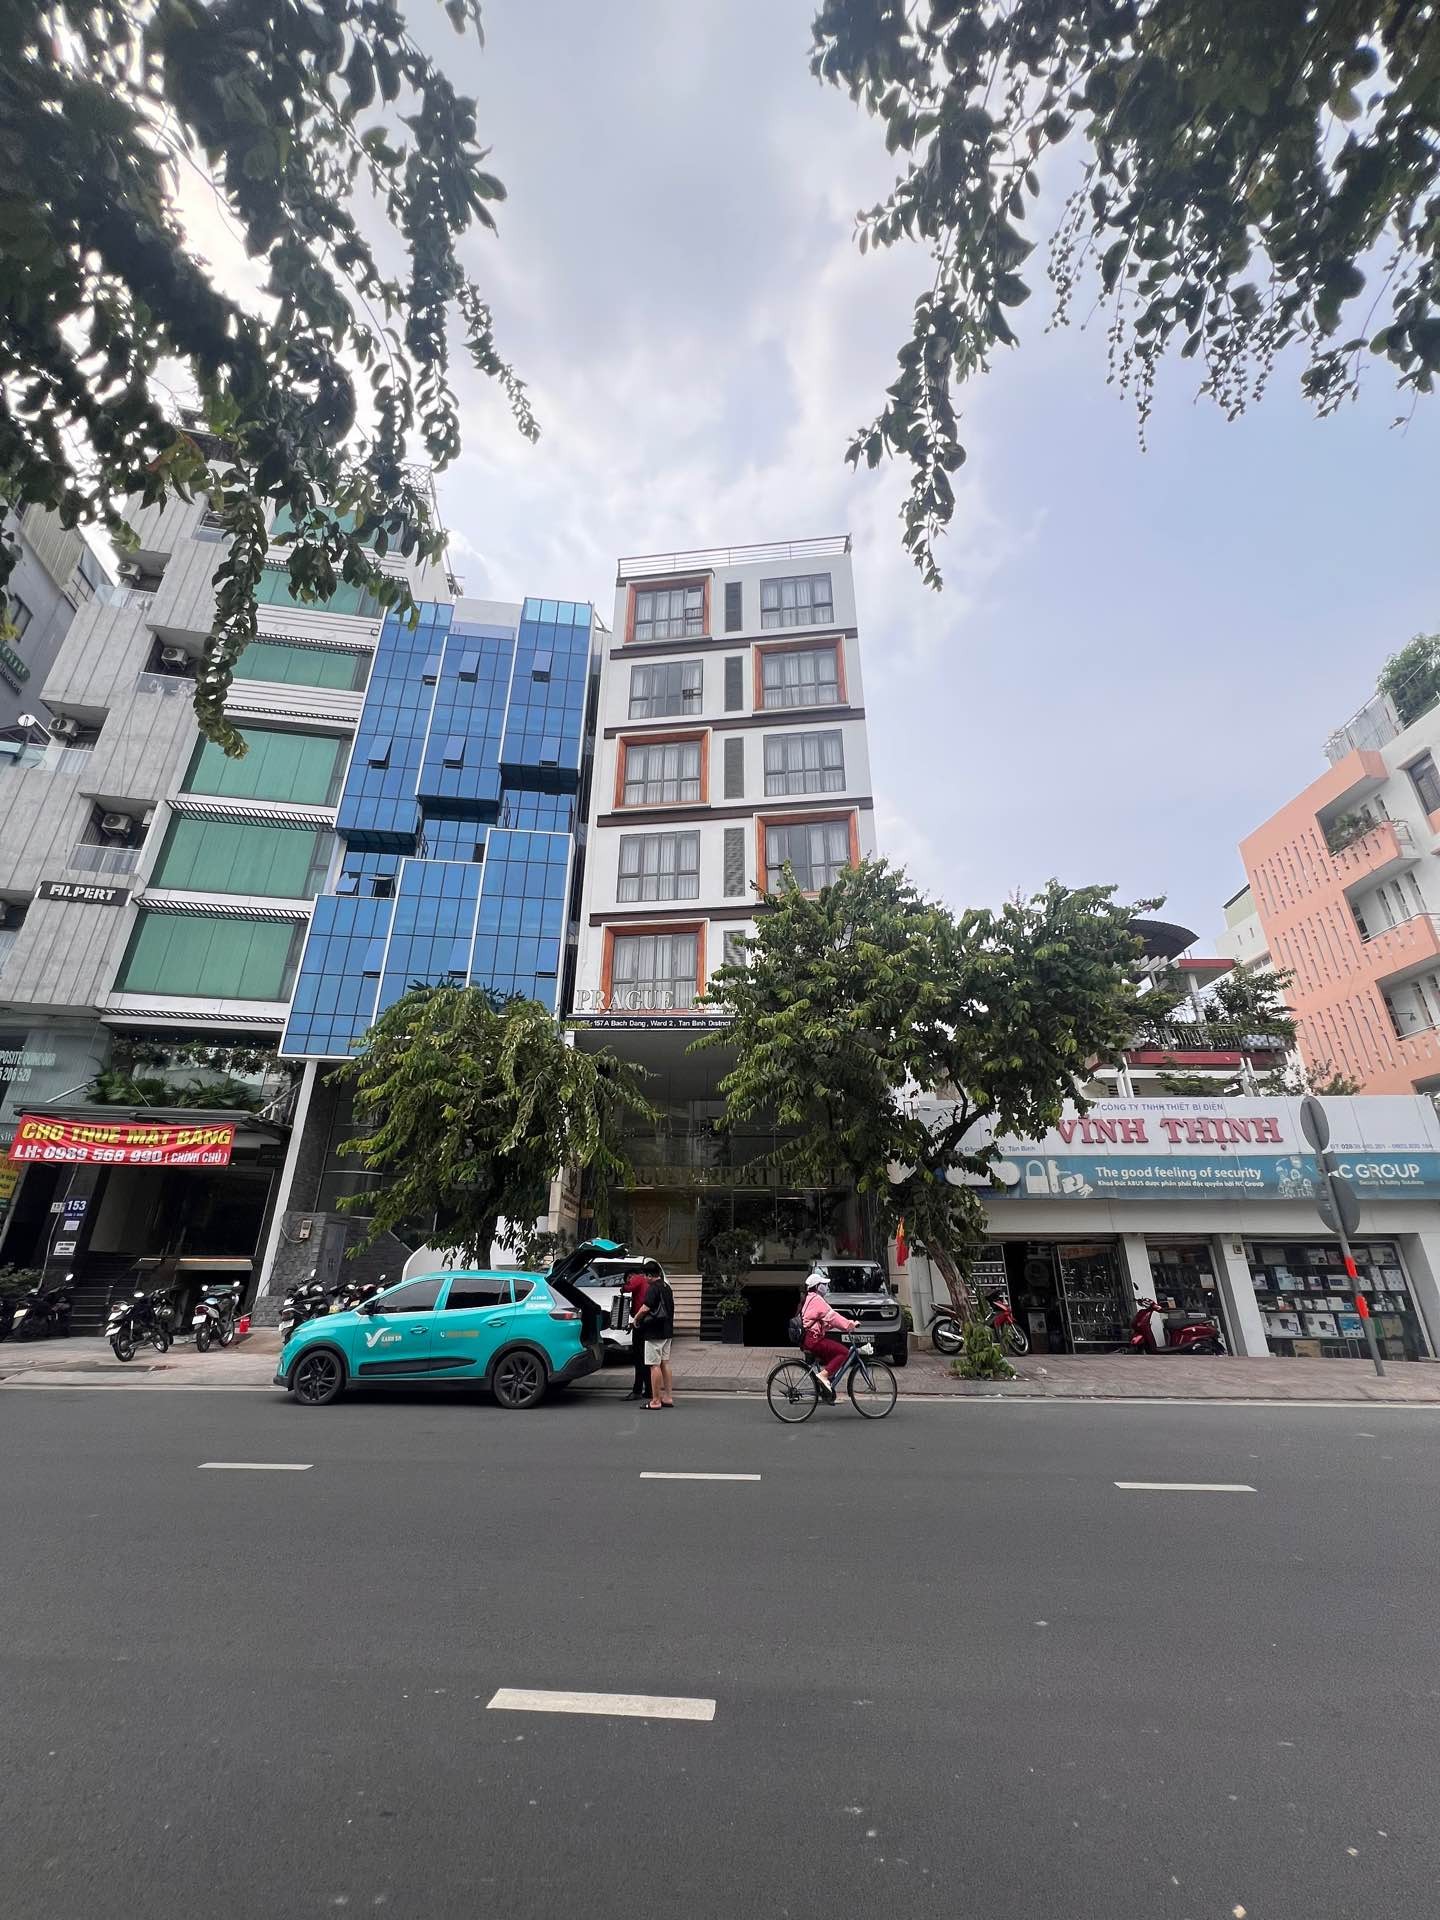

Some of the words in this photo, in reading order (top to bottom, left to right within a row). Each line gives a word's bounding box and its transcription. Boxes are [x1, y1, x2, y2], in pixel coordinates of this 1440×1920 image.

[575, 989, 674, 1011] PRAGUE
[1101, 1101, 1127, 1111] CÔNG
[1128, 1103, 1139, 1111] TY
[1141, 1103, 1165, 1111] TNHH
[22, 1122, 64, 1140] CHO
[1160, 1117, 1284, 1151] THỊNH
[14, 1145, 42, 1158] LH:
[43, 1146, 88, 1160] 0989
[92, 1149, 125, 1161] 568
[1095, 1166, 1119, 1178] The
[1120, 1166, 1153, 1180] good
[1154, 1166, 1198, 1180] feeling
[1199, 1166, 1214, 1178] of
[1214, 1167, 1261, 1180] security
[1355, 1163, 1420, 1178] GROUP
[67, 1200, 87, 1211] 153
